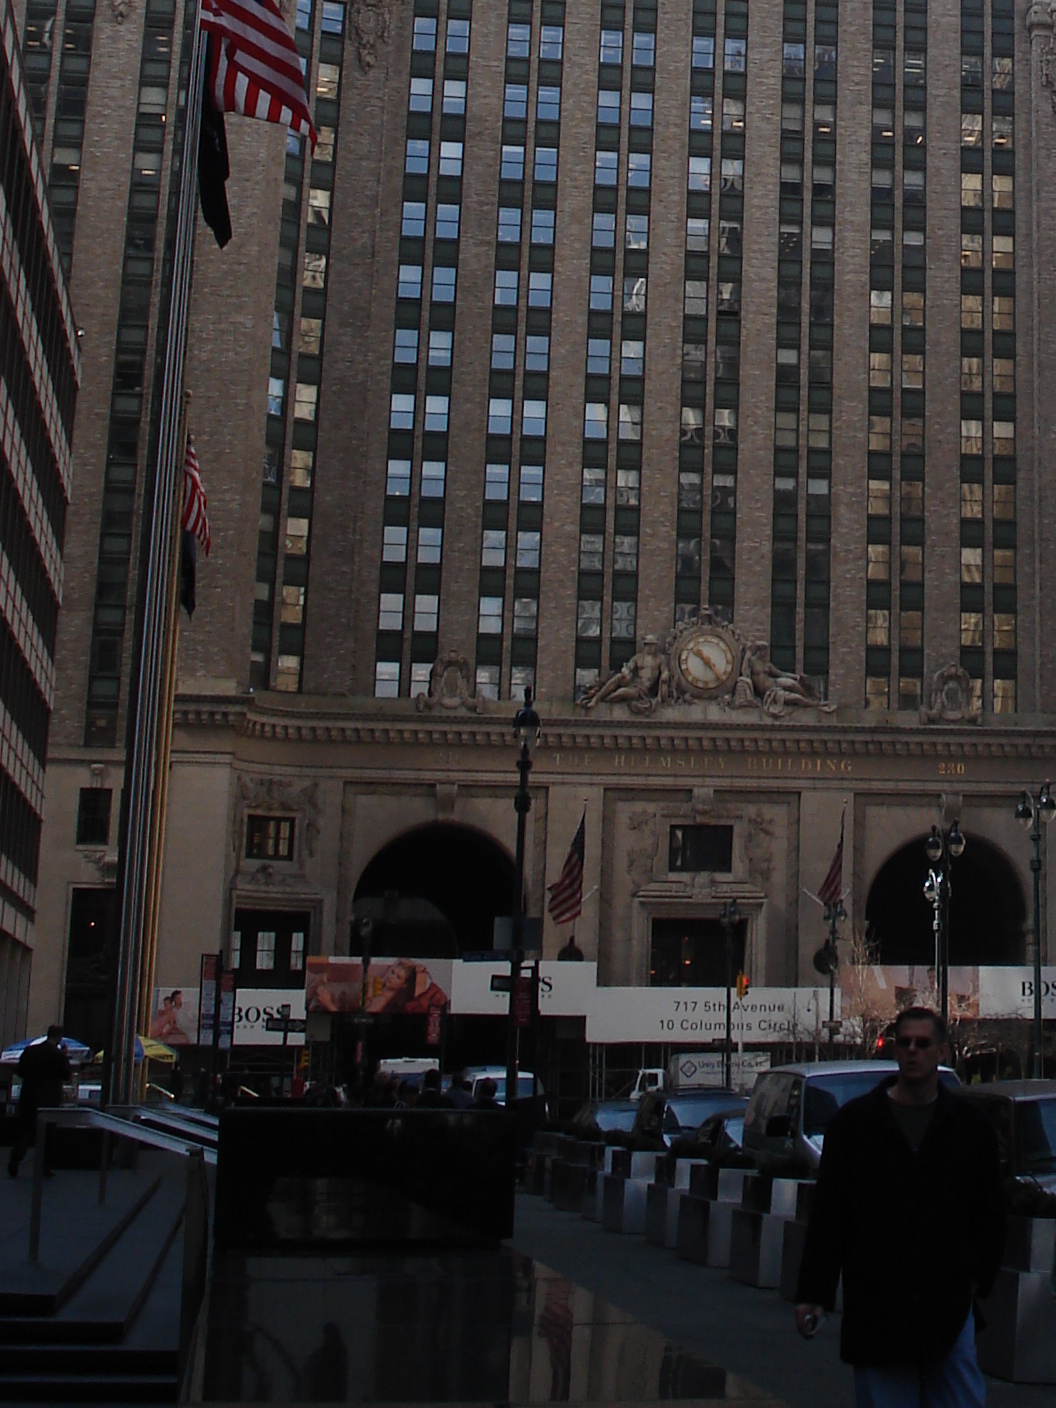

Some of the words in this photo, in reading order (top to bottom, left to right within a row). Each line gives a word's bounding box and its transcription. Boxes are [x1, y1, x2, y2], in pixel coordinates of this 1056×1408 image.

[553, 753, 593, 766] THE
[748, 757, 852, 772] BUILDING
[673, 1000, 698, 1012] 717
[703, 1000, 726, 1012] 5th
[731, 1000, 785, 1013] Avenue
[234, 1006, 284, 1023] BOS
[659, 1019, 674, 1031] 10
